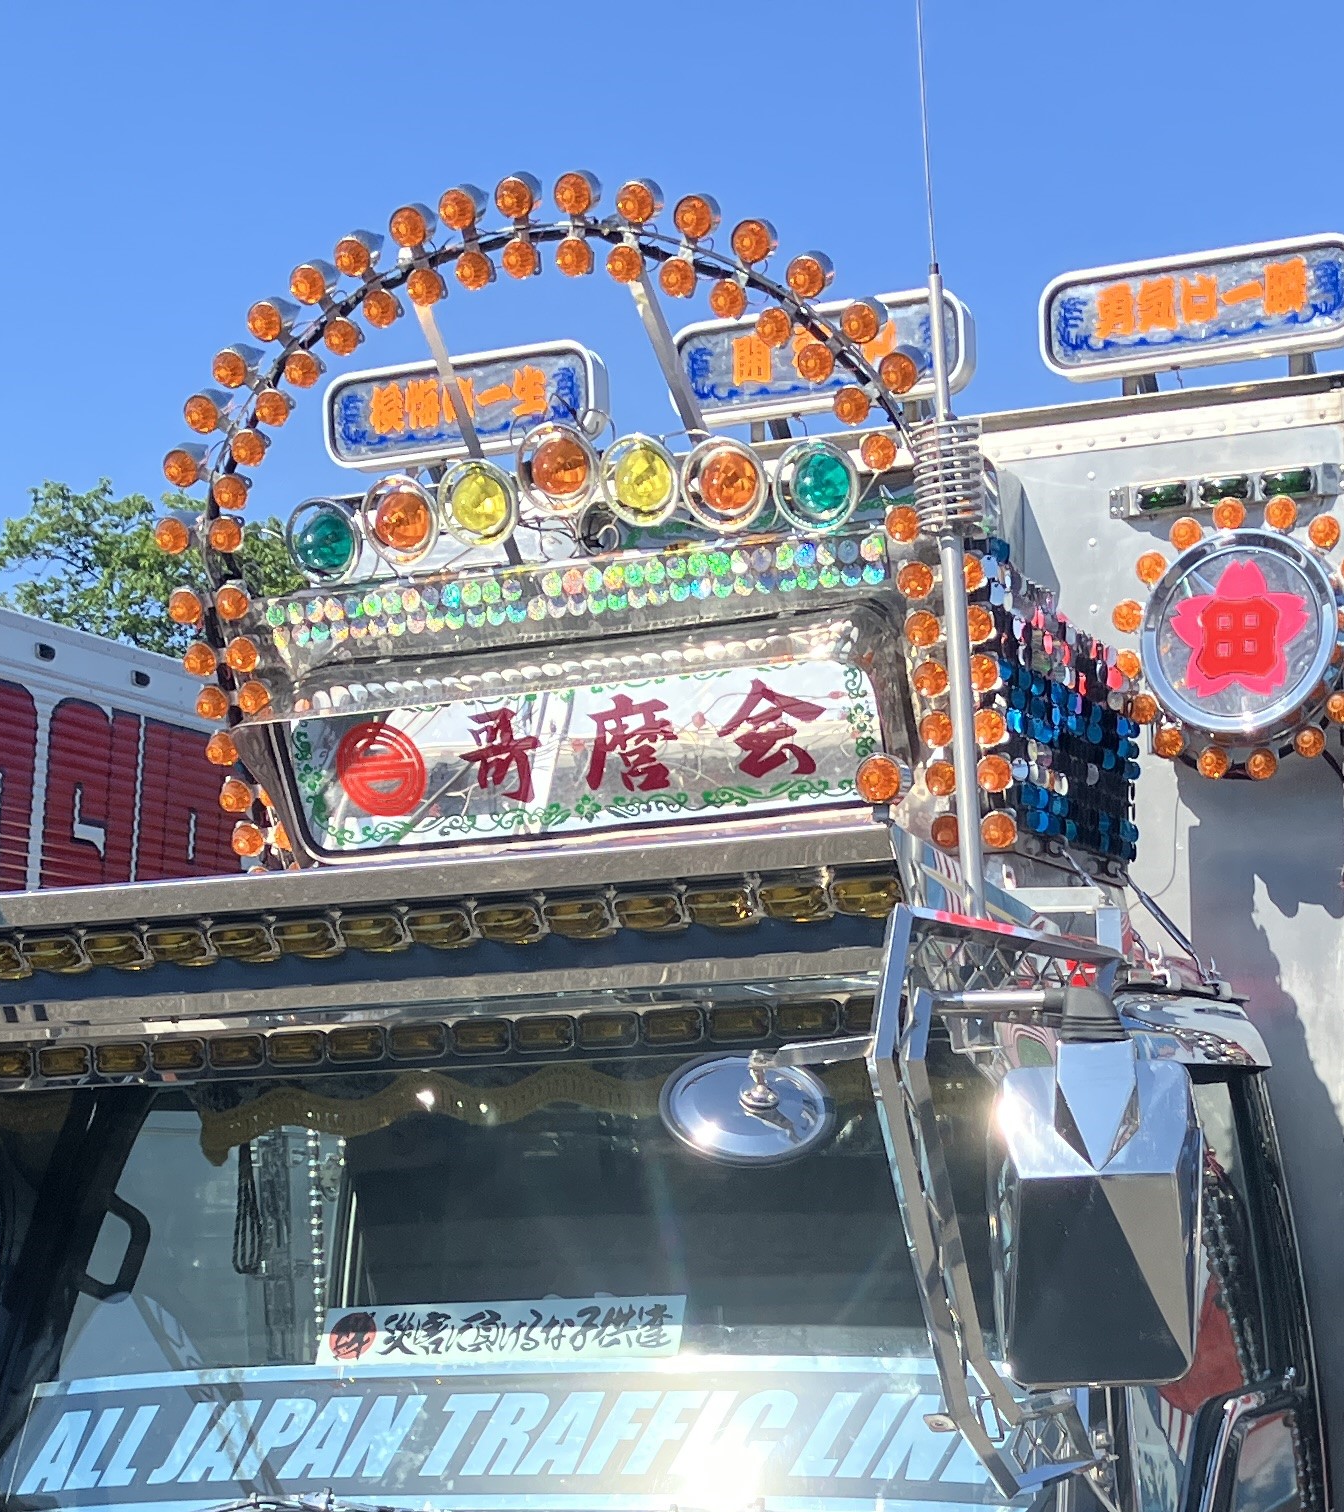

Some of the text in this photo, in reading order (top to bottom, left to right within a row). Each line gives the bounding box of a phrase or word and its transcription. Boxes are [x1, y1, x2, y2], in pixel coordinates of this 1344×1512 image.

[16, 1404, 160, 1495] ALL
[147, 1394, 429, 1484] JAPAN
[419, 1388, 800, 1477] TRAFFIC
